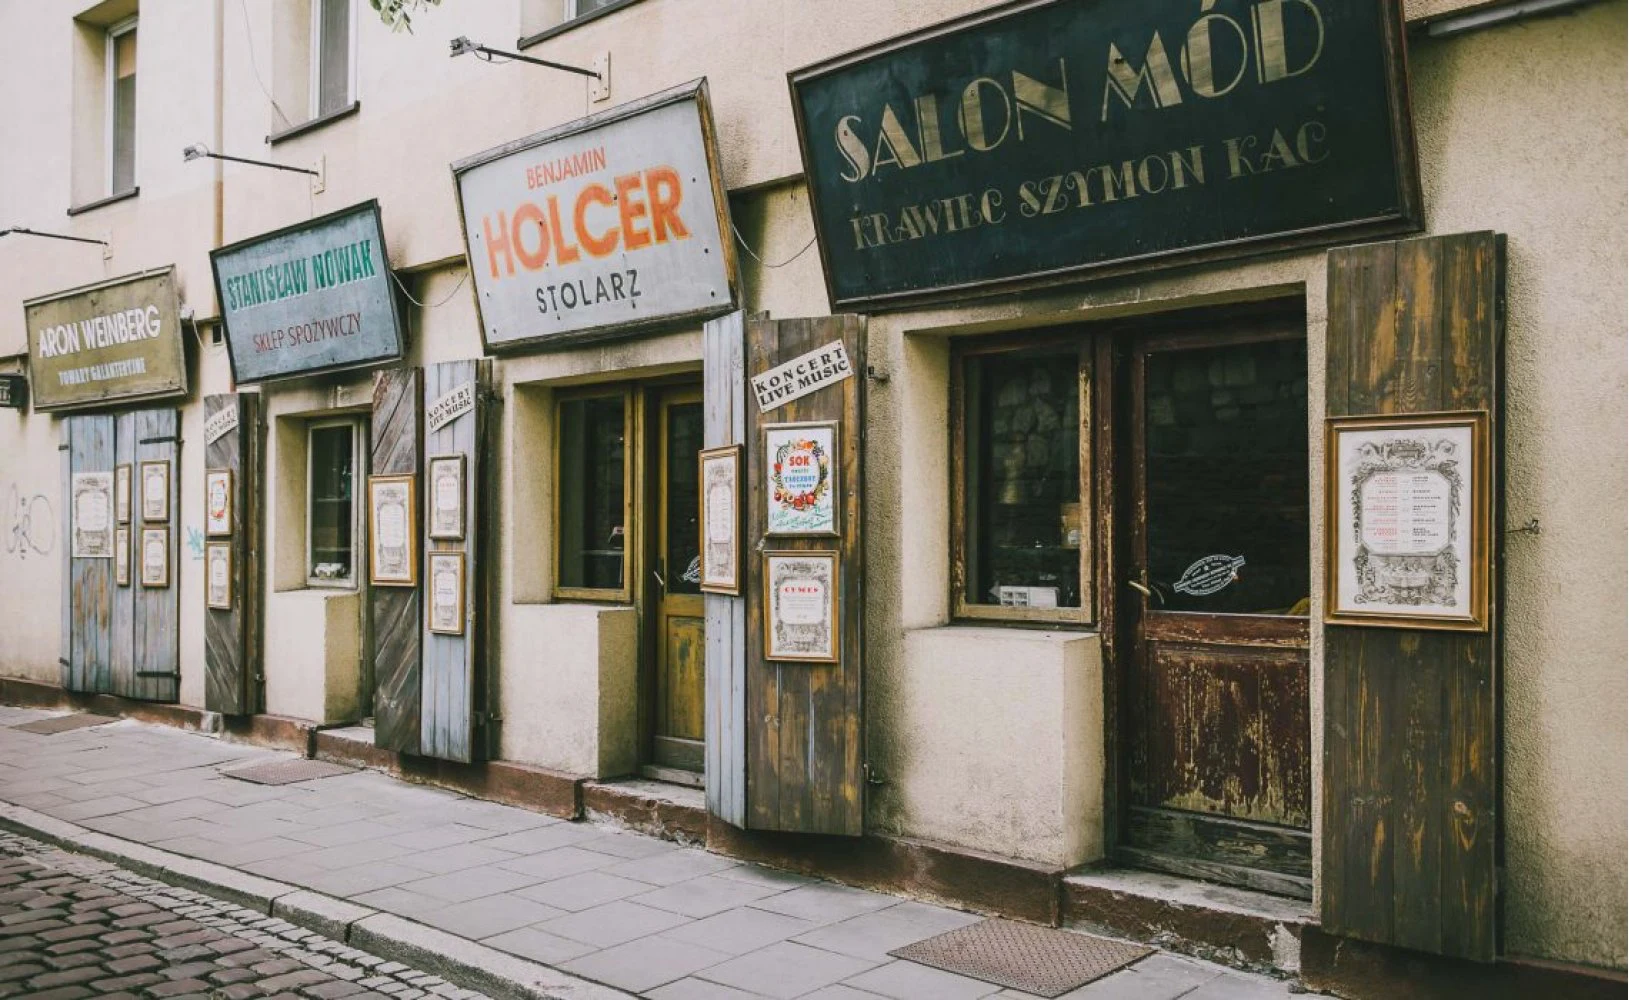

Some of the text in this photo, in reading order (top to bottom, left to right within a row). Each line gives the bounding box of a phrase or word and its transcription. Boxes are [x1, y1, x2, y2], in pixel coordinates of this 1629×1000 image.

[834, 0, 1325, 183] SALON MÓD
[526, 147, 606, 190] BENJAMIN
[850, 121, 1331, 251] KRAWIEC SZYMON KAC
[482, 165, 692, 279] HOLCER
[226, 240, 375, 312] STANISŁAW NOWAK
[535, 269, 643, 315] STOLARZ
[38, 304, 161, 359] ARON WEINBERG
[252, 312, 362, 354] SKLEP SPOŻYWCZY
[755, 347, 843, 394] KONCERT
[759, 359, 850, 406] LIVE MUSIC
[428, 387, 469, 420] KONCERT
[789, 456, 810, 467] SOK
